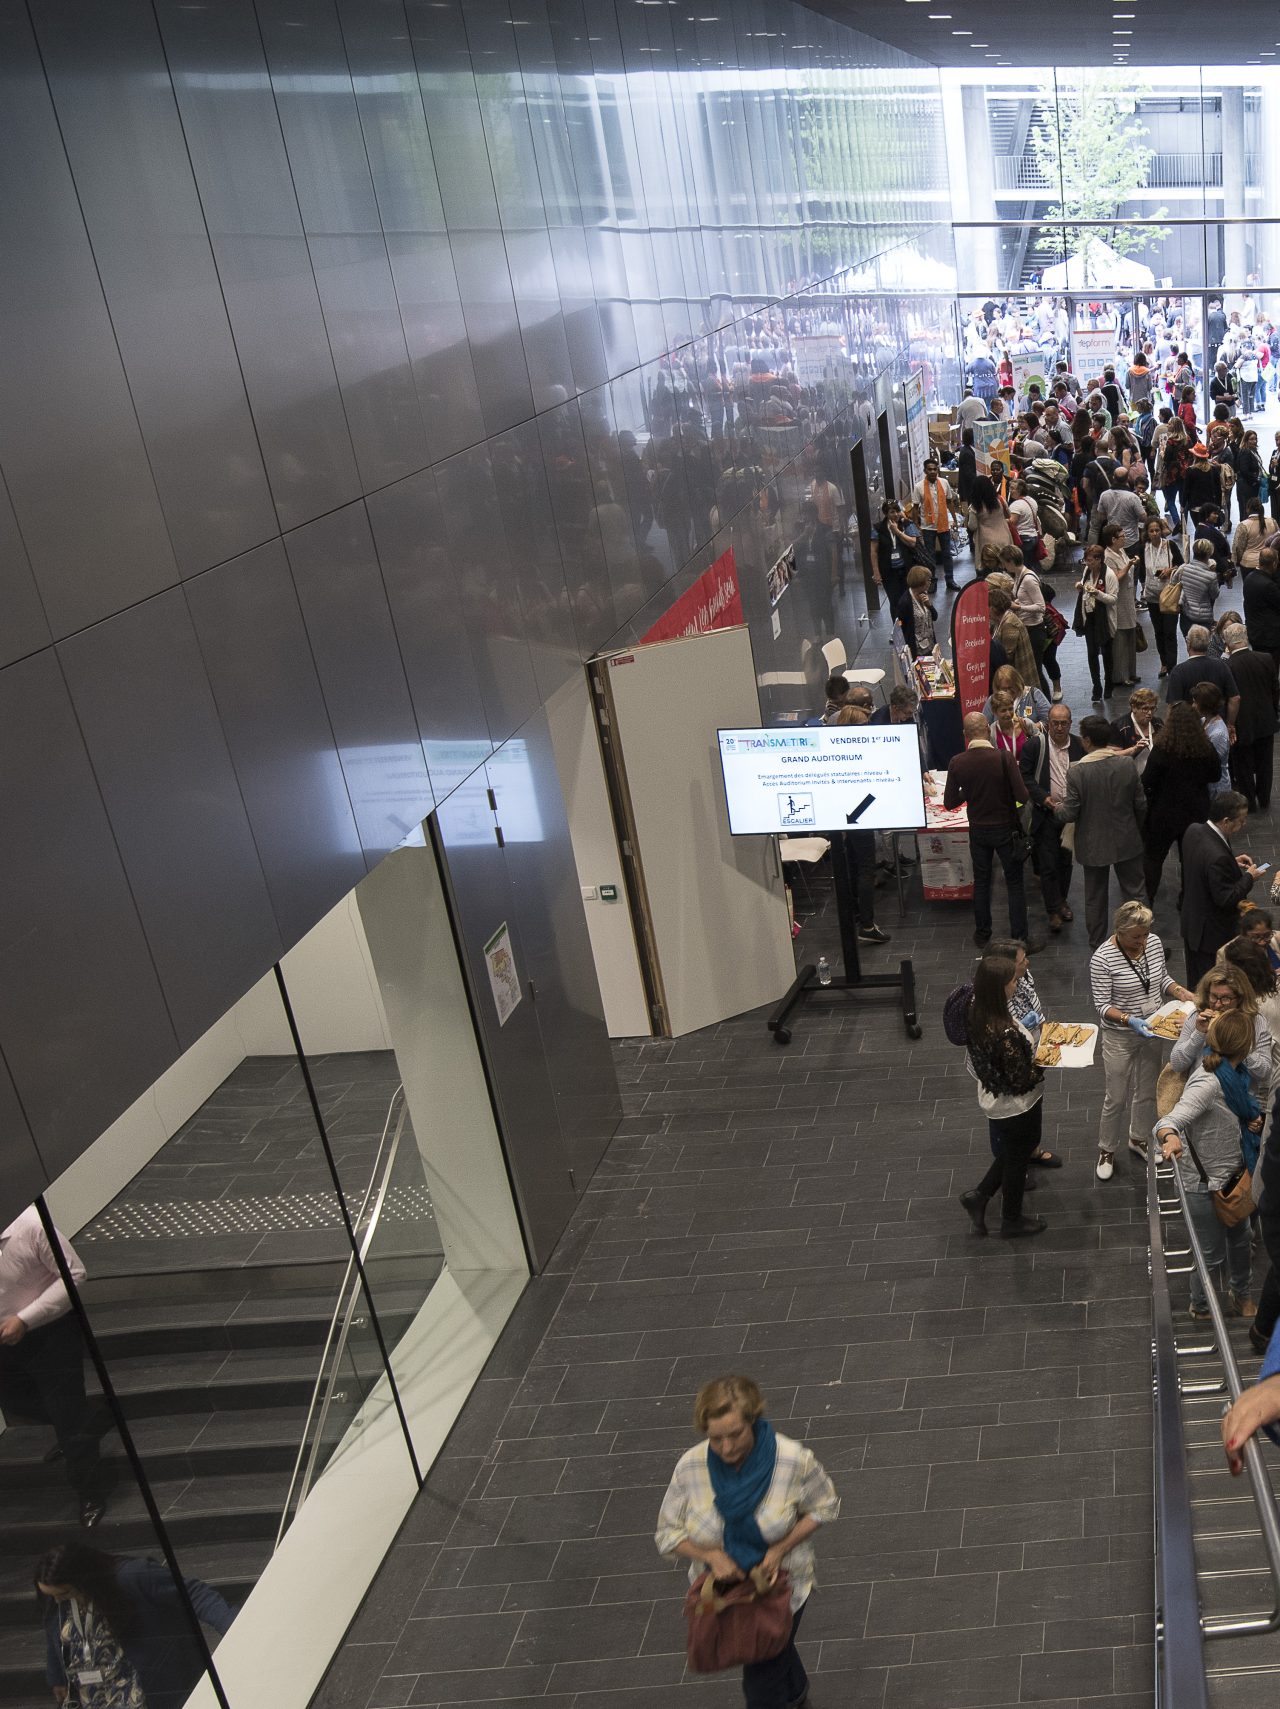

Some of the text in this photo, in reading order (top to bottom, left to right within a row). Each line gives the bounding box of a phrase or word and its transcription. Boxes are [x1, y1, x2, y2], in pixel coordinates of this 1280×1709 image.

[829, 736, 870, 745] VENDREDI
[882, 735, 901, 743] JUIN
[781, 754, 863, 763] GRAND AUDITORIUM
